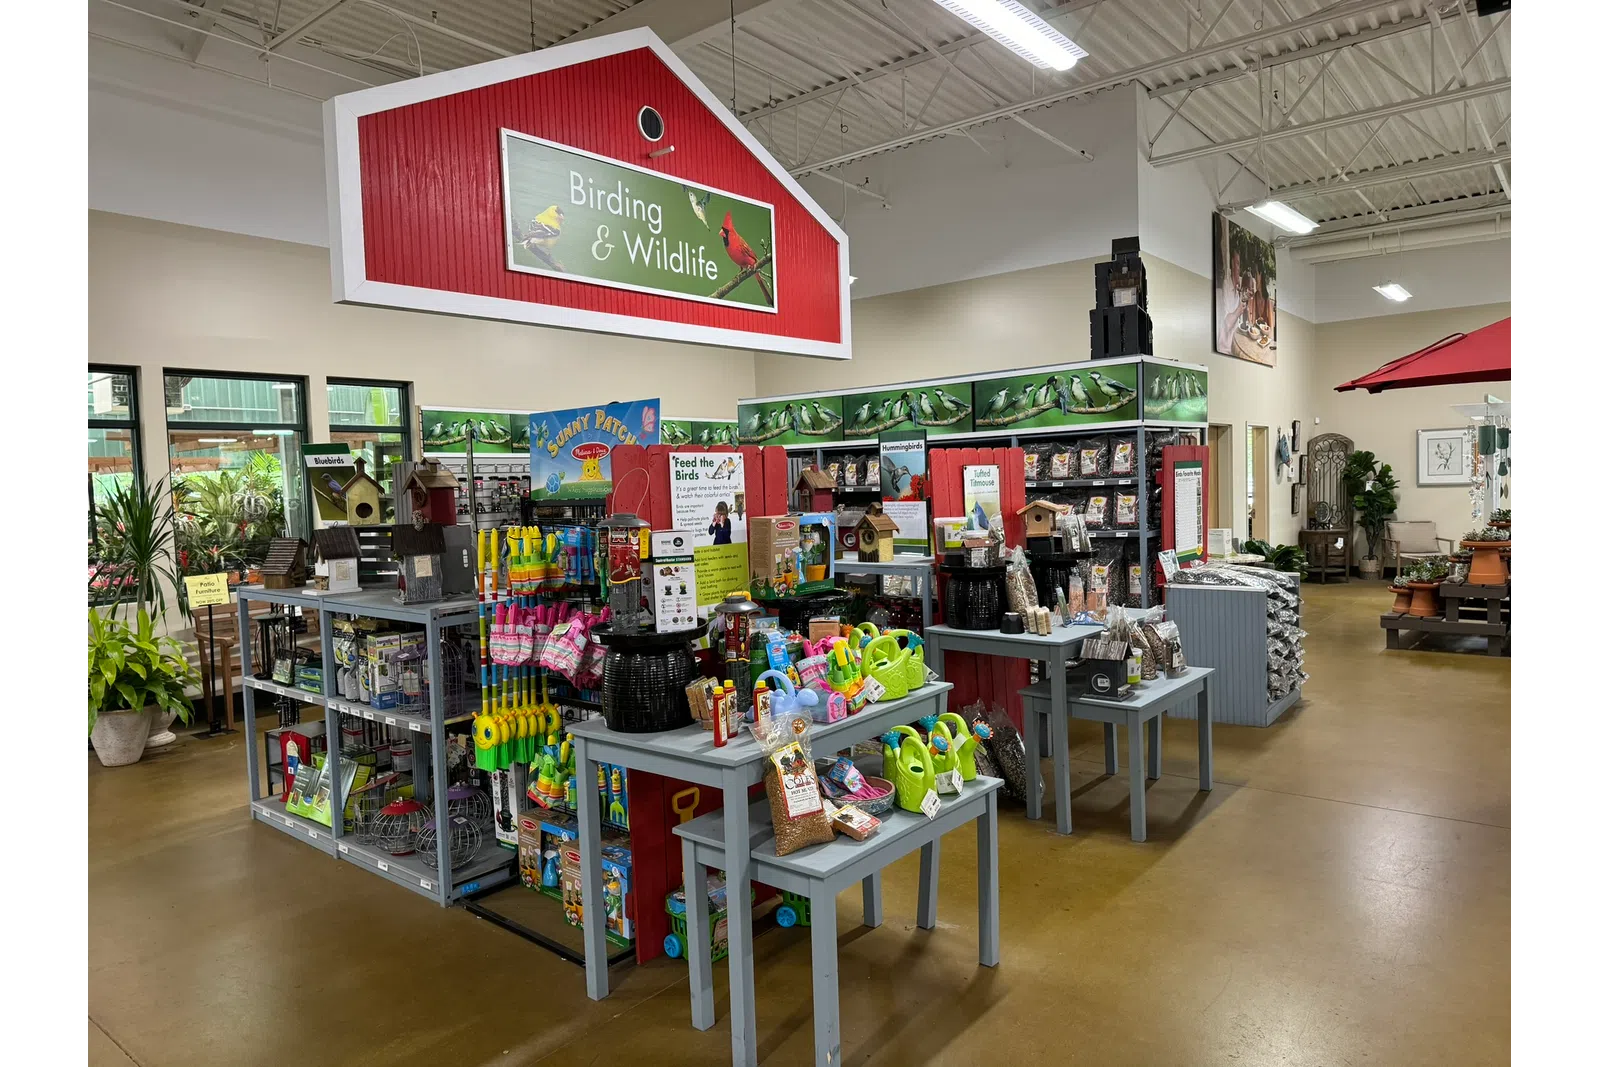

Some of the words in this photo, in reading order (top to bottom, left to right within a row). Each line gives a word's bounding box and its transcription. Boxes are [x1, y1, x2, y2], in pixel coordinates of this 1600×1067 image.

[570, 170, 662, 234] Birding
[592, 224, 615, 261] &
[622, 230, 718, 280] Wildlife
[547, 413, 590, 458] SUNNY
[595, 409, 636, 445] PATCH
[882, 442, 923, 452] Hummingbirds
[314, 456, 344, 464] Bluebirds
[674, 456, 697, 468] Feed
[700, 456, 714, 468] the
[676, 470, 700, 480] Birds
[974, 468, 990, 477] Tufted
[970, 478, 995, 487] Titmouse
